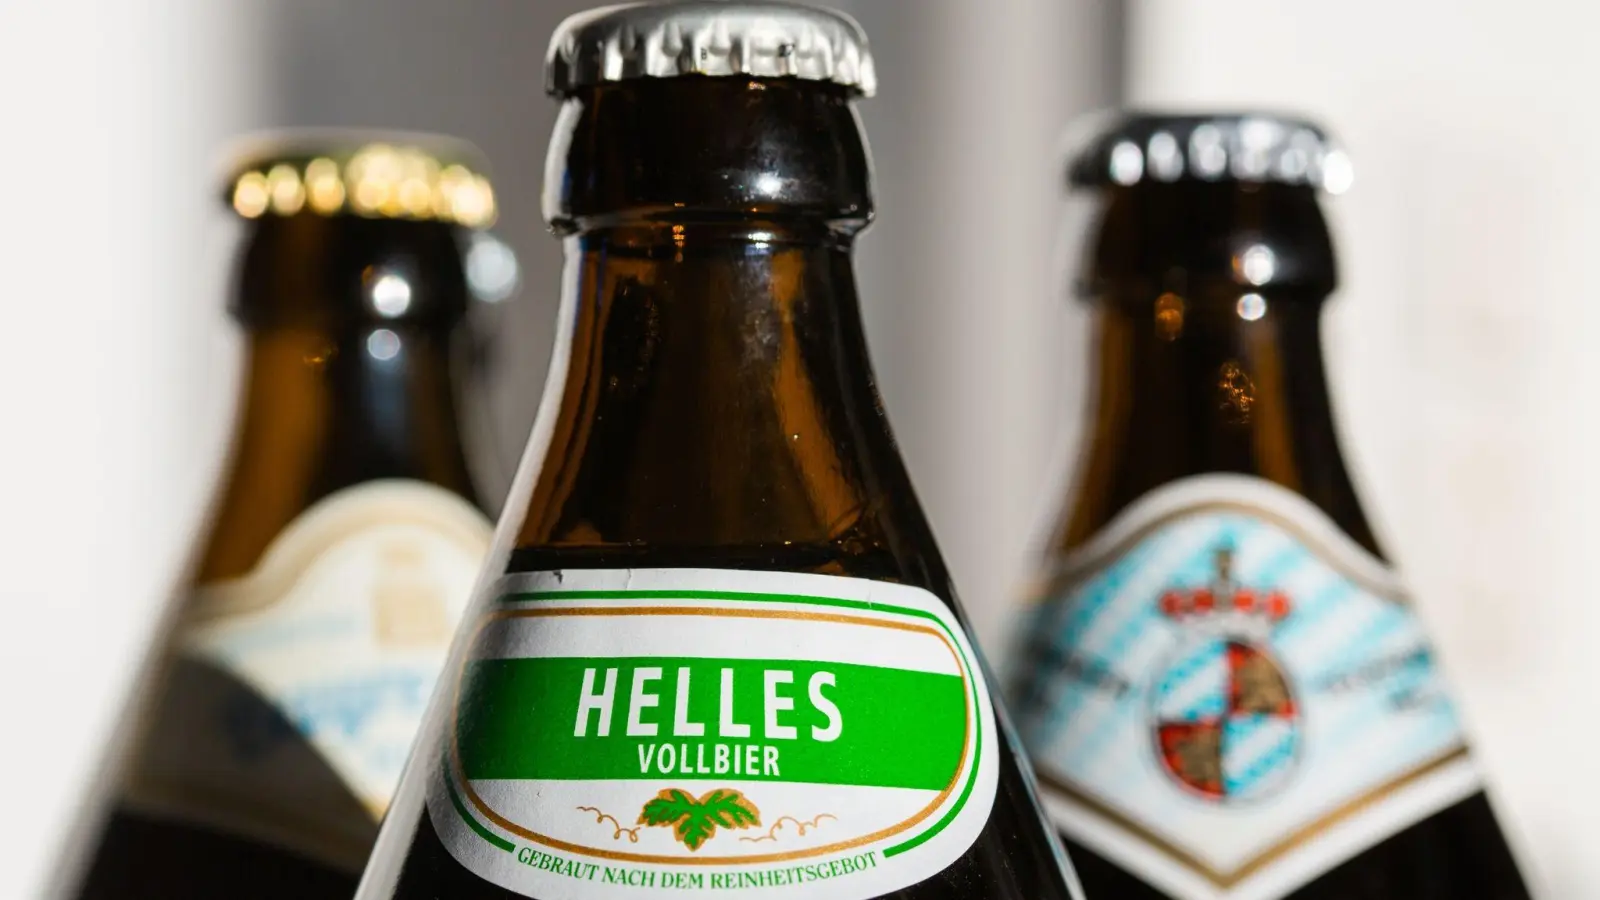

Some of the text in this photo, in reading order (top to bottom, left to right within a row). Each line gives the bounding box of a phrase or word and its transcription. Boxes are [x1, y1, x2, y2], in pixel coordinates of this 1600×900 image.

[574, 667, 843, 742] HELLES
[637, 743, 780, 777] VOLLBIER
[517, 846, 877, 889] GEBRAUT NACH DEM REINHEITSGEBOT
